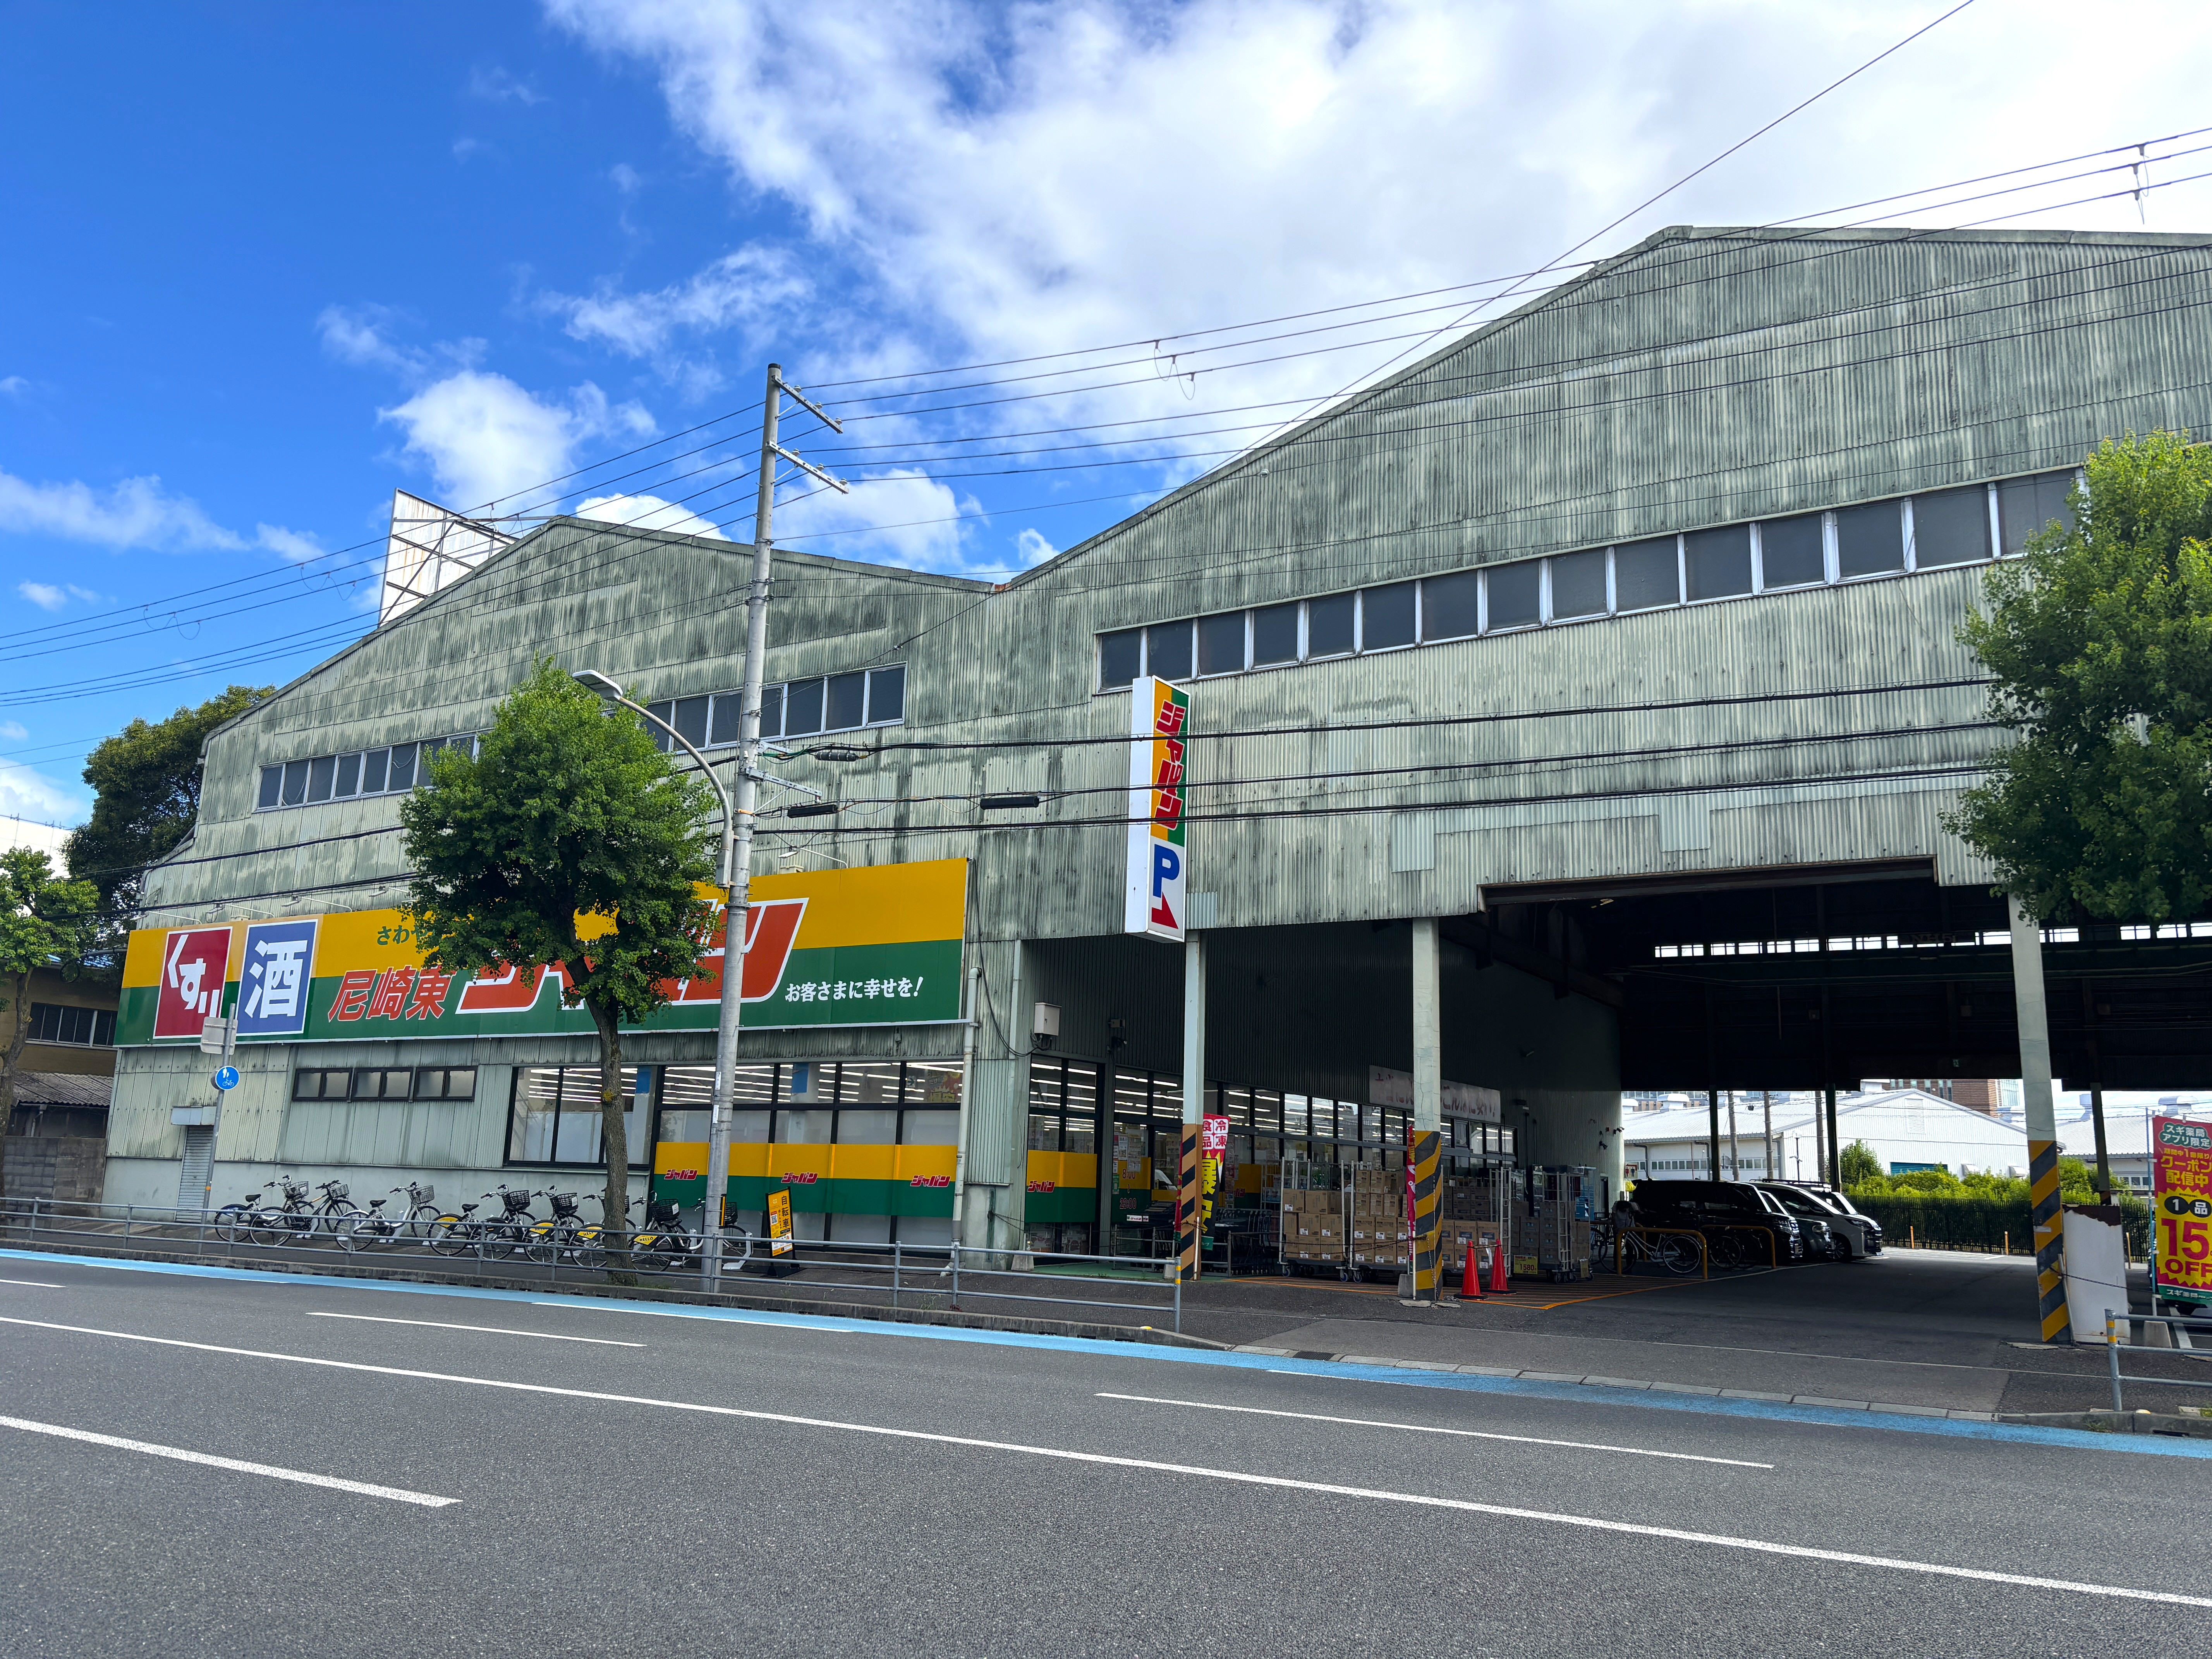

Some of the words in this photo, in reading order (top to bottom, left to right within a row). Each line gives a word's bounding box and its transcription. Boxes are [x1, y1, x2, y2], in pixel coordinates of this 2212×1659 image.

[1155, 699, 1187, 831] ジャパン
[1152, 843, 1180, 898] P
[168, 934, 220, 1018] くすり
[245, 940, 307, 1018] 酒
[328, 965, 458, 1022] 尼崎東
[785, 976, 924, 1003] お客さまに幸せを!
[1215, 1120, 1227, 1147] 冷凍
[2162, 1133, 2210, 1147] アプリ限定
[2166, 1125, 2205, 1137] スギ薬局
[664, 1169, 698, 1180] ジャパン
[2160, 1156, 2212, 1173] クーポン
[781, 1171, 819, 1184] ジャパン
[910, 1175, 951, 1188] ジャパン
[1027, 1180, 1056, 1193] ジャパン
[2166, 1169, 2209, 1188] 配信中
[781, 1195, 790, 1228] 自転車
[2161, 1218, 2212, 1260] 15
[2165, 1259, 2212, 1278] OFF
